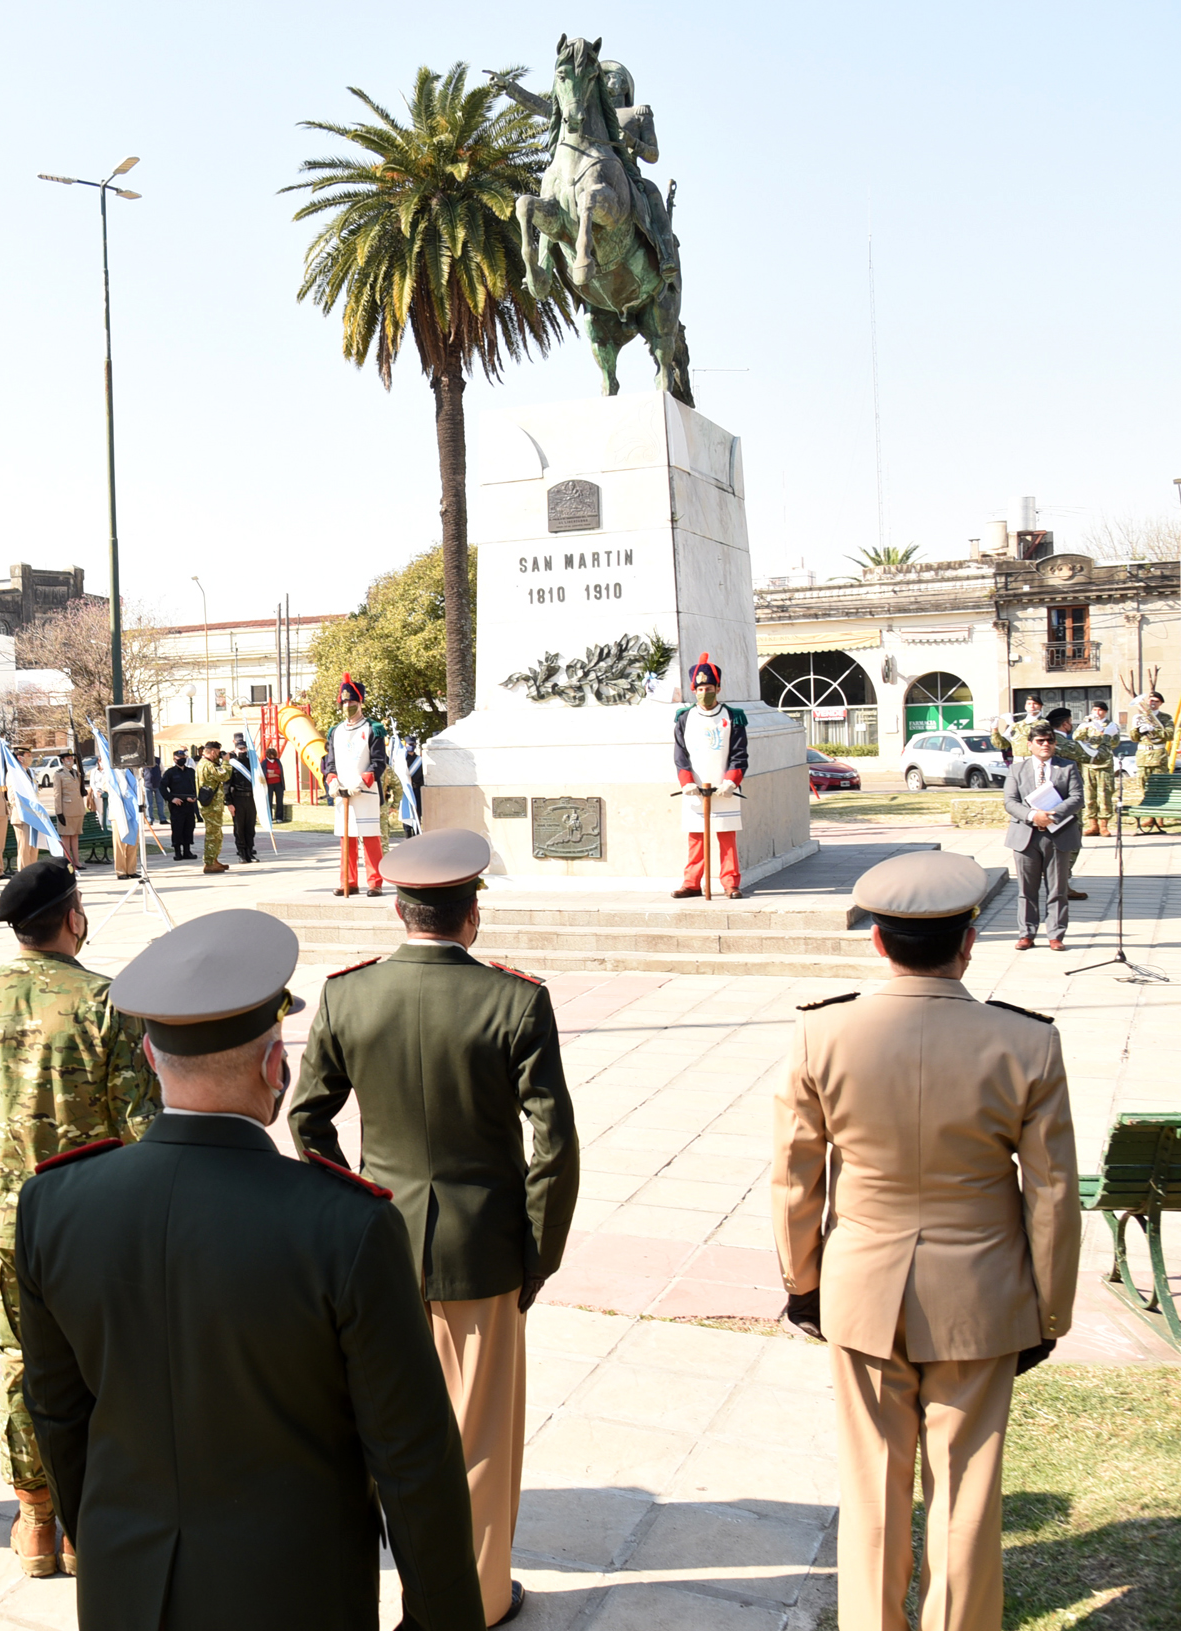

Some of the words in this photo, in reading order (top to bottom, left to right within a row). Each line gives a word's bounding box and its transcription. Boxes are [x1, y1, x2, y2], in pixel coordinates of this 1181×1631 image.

[519, 555, 553, 573] SAN
[564, 549, 633, 570] MARTIN
[528, 586, 565, 604] 1810
[585, 582, 622, 601] 1910
